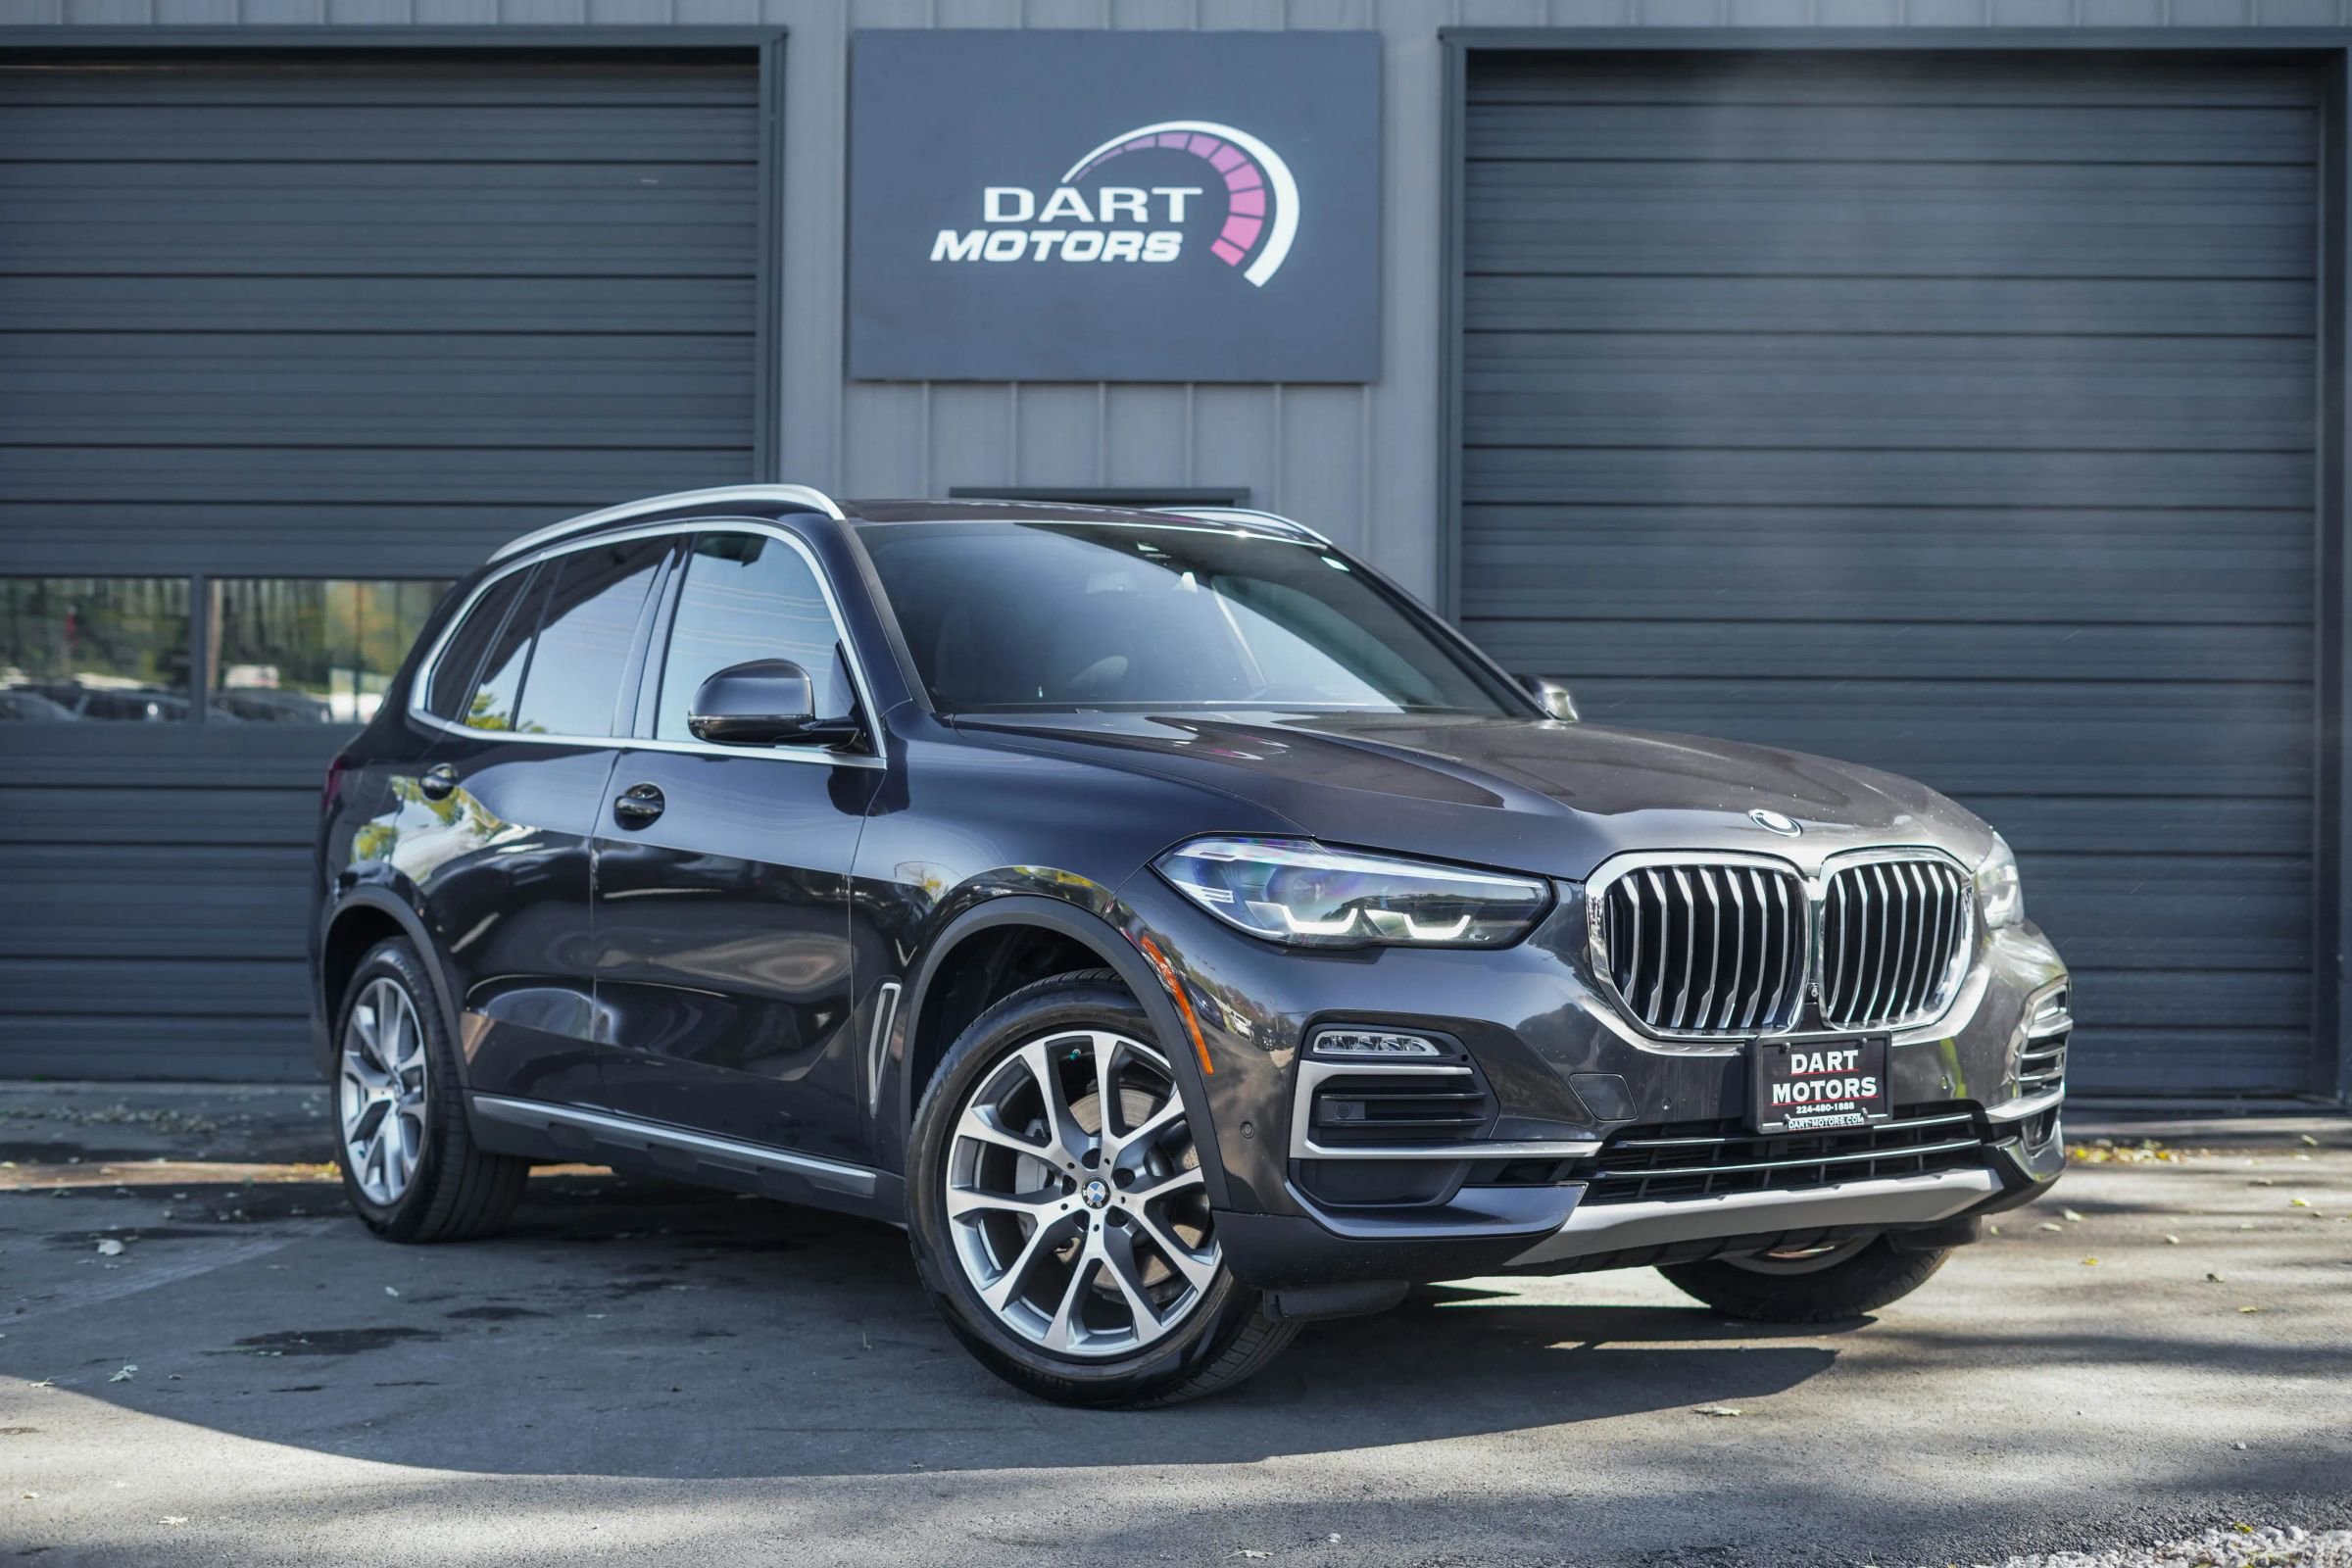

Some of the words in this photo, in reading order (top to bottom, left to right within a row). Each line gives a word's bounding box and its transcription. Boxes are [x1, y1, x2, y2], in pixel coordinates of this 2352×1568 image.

[984, 186, 1203, 222] DART
[930, 229, 1183, 262] MOTORS
[1791, 1050, 1858, 1074] DART
[1773, 1077, 1877, 1103] MOTORS
